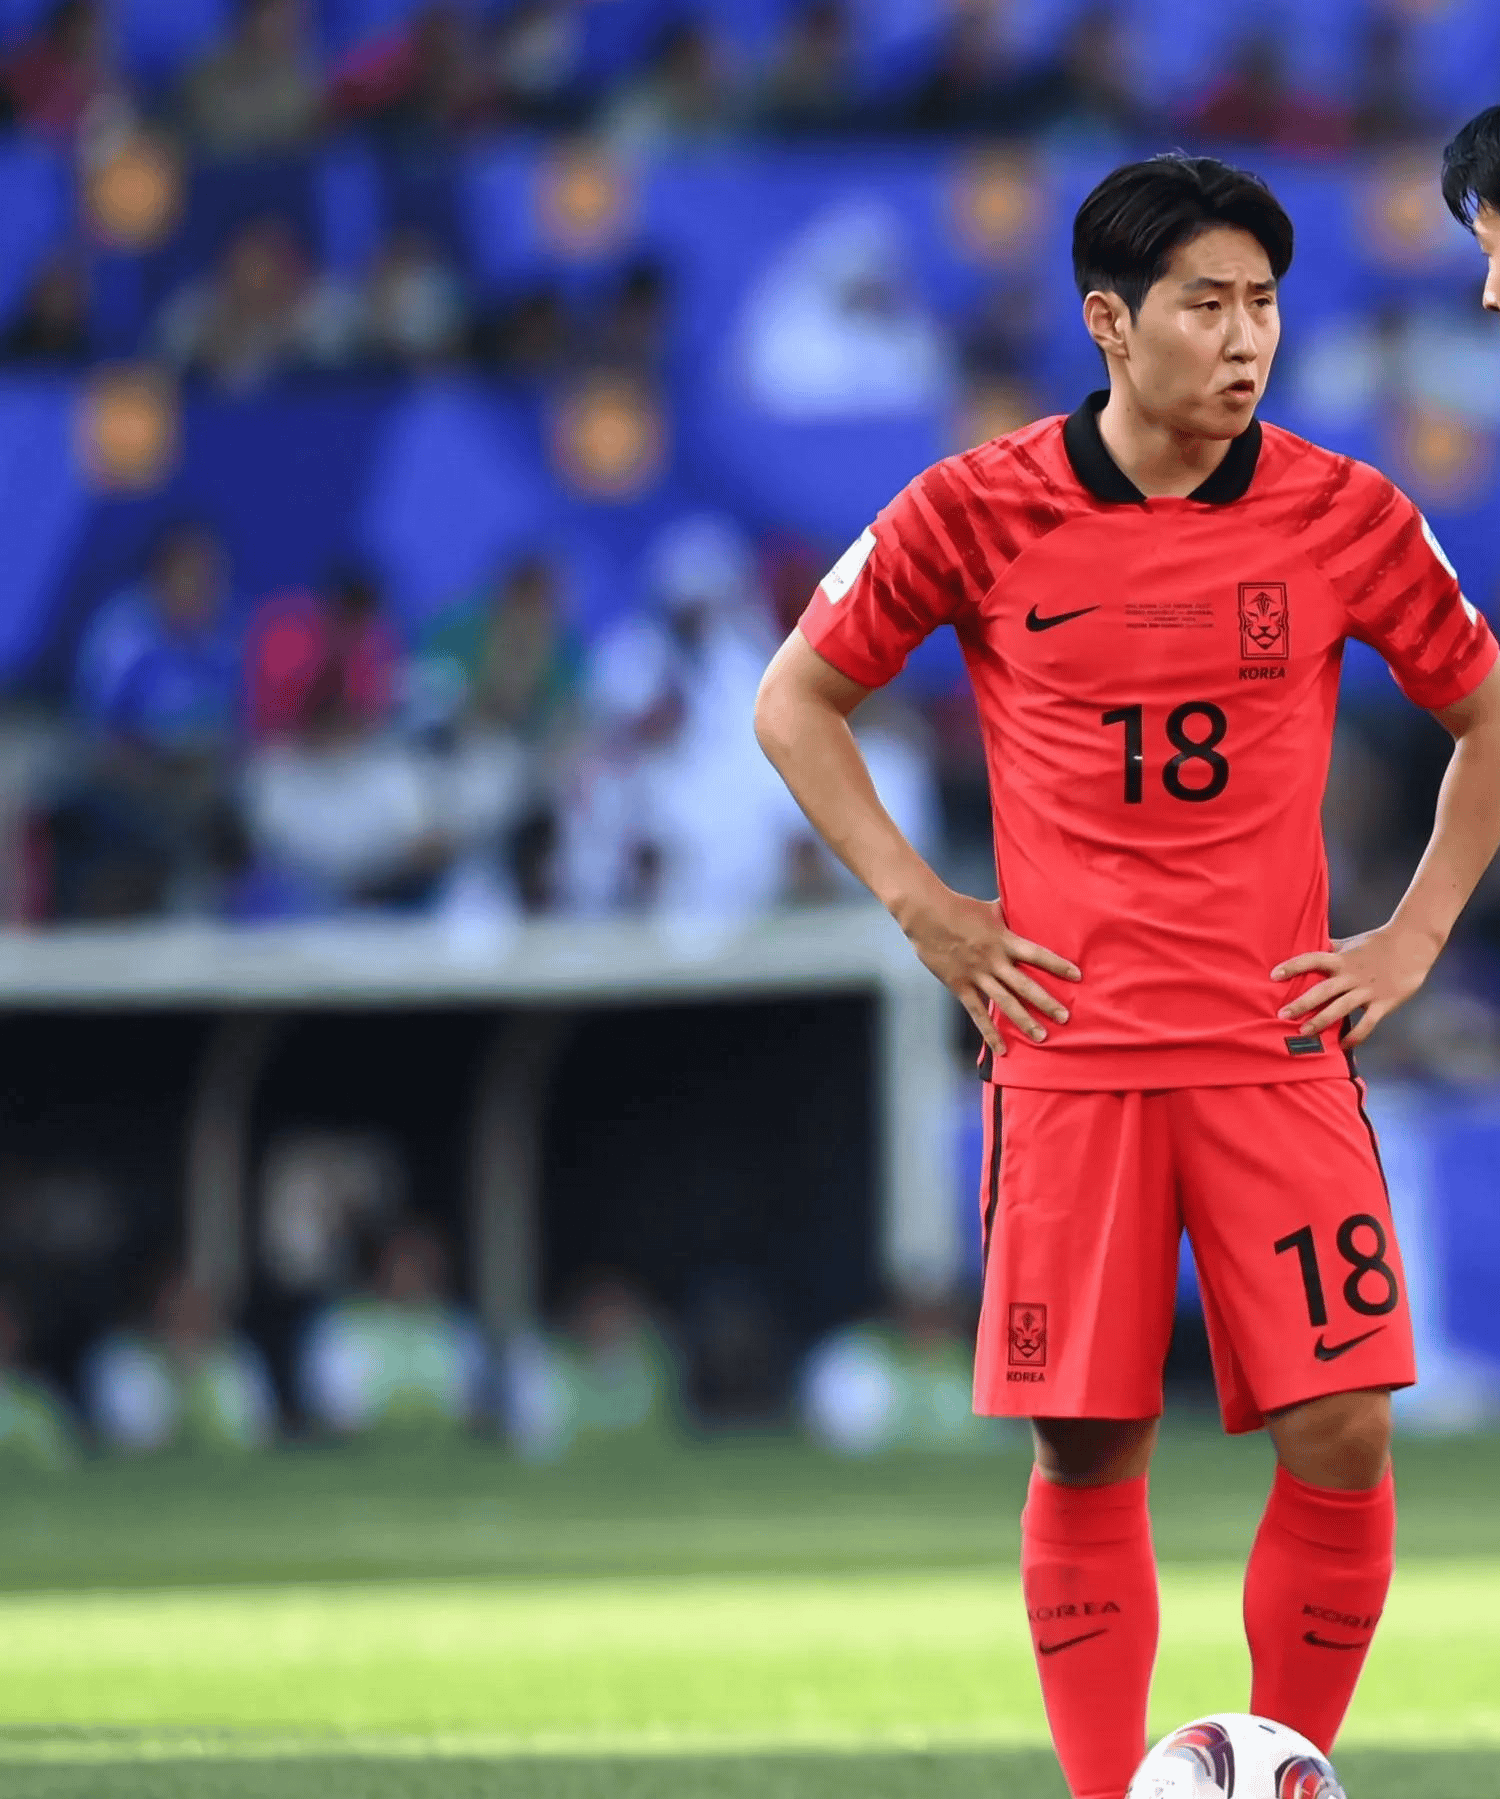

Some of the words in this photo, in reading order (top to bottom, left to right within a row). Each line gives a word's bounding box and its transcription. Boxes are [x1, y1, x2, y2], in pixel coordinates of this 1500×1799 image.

[1238, 666, 1286, 680] KOREA
[1101, 700, 1230, 805] 18
[1273, 1212, 1398, 1328] 18
[1006, 1370, 1046, 1382] KOREA
